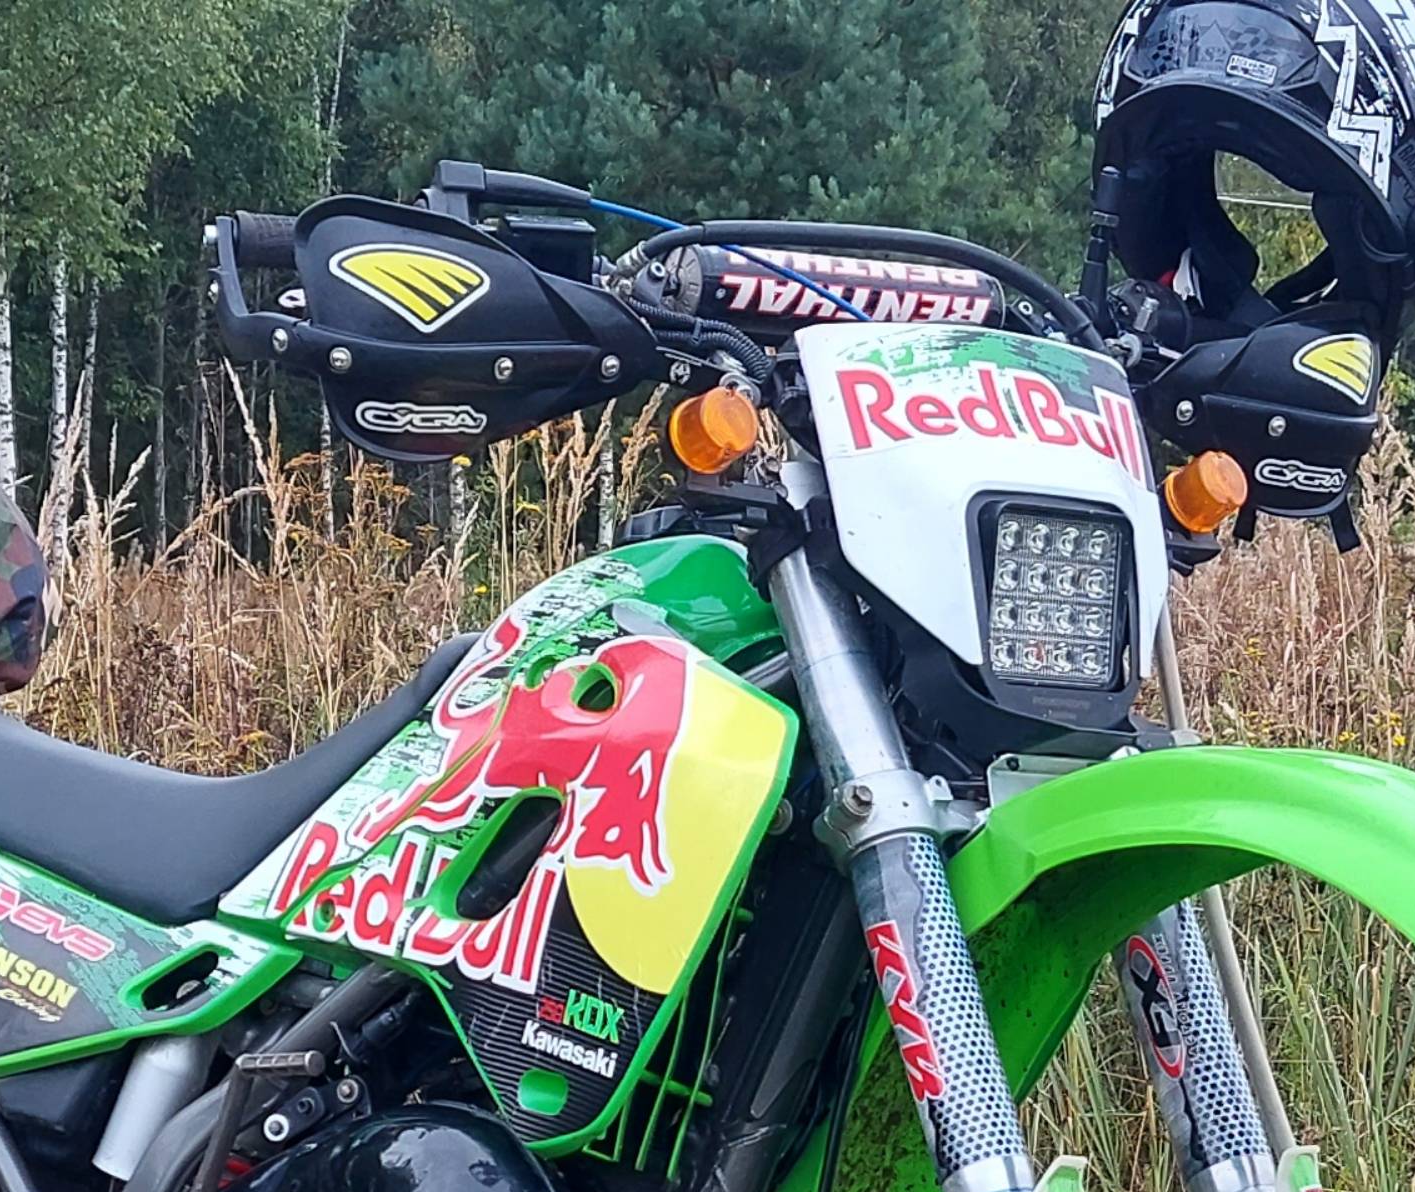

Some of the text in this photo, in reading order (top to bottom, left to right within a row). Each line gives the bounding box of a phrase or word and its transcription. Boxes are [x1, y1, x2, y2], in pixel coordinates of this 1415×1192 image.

[722, 273, 991, 325] RENTHAL
[836, 369, 1142, 482] Red Bull
[275, 820, 418, 946] Red
[10, 903, 115, 961] EVS
[563, 988, 625, 1044] KDX
[866, 920, 946, 1103] KYB
[521, 1019, 618, 1078] Kawasaki
